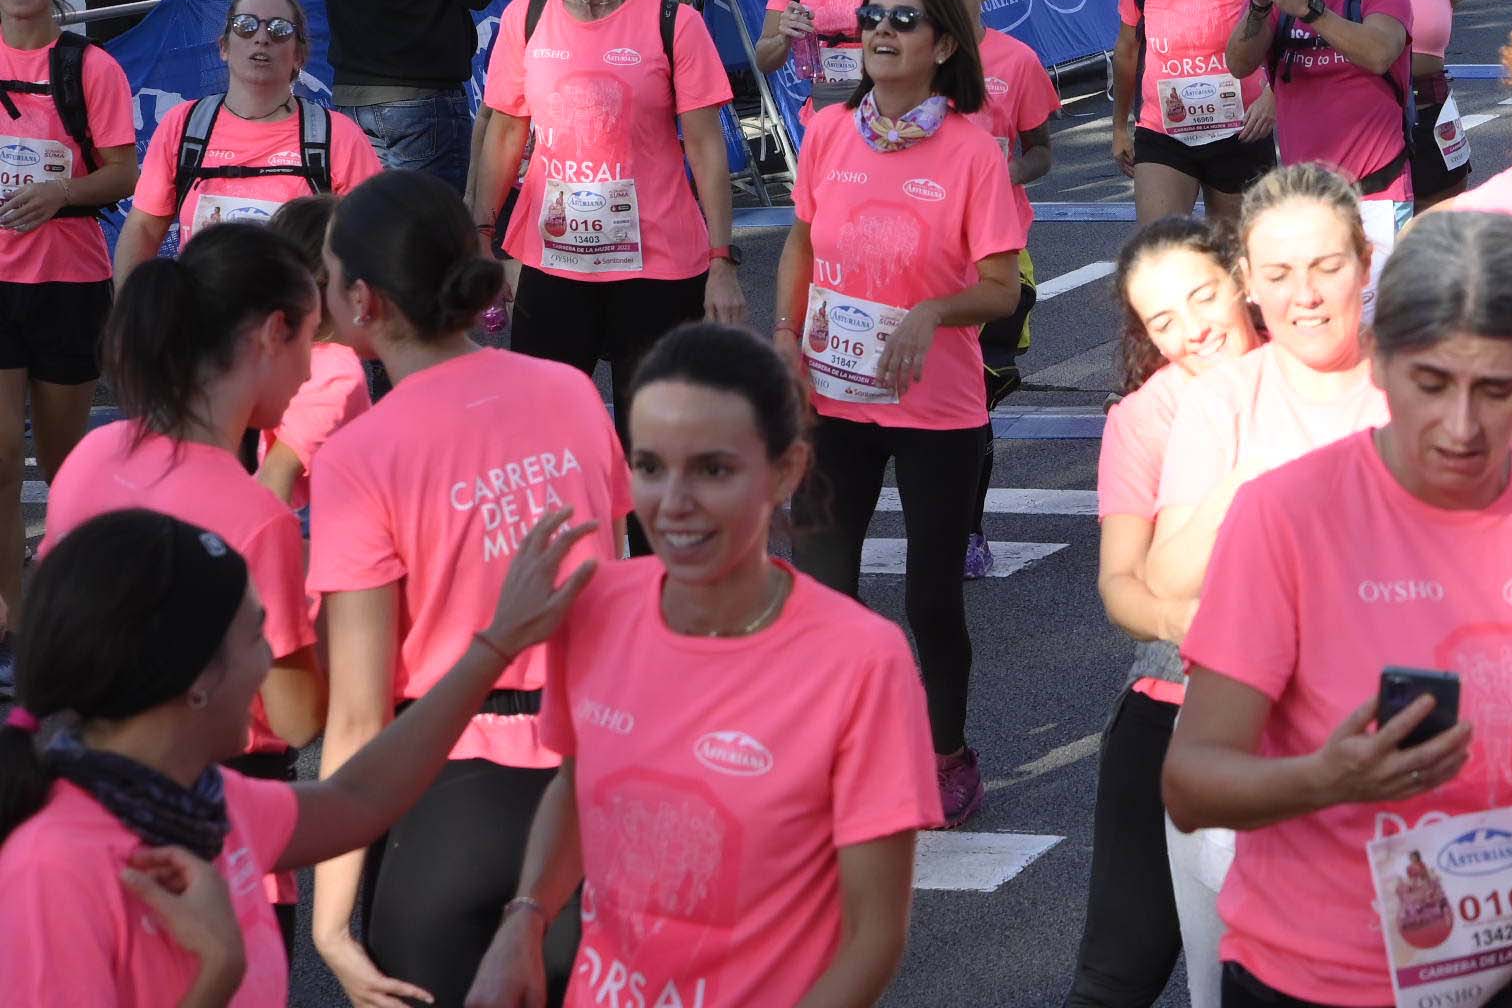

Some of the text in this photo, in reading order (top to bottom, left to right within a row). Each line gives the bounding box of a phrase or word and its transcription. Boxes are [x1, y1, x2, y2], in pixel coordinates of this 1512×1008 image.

[1187, 103, 1215, 115] 016
[569, 219, 603, 232] 016
[574, 235, 600, 244] 13403
[601, 257, 634, 265] Santander
[815, 257, 842, 286] TU
[832, 310, 872, 329] ASTURIANA
[830, 335, 865, 357] 016
[808, 360, 871, 385] CARRERA DE LA MUJER
[831, 354, 857, 370] 31847
[450, 448, 582, 512] CARRERA
[480, 485, 563, 531] DE LA
[1357, 579, 1446, 605] OYSHO
[702, 741, 768, 770] ASTURIANA
[1418, 957, 1477, 981] CARRERA
[1478, 953, 1496, 969] DE
